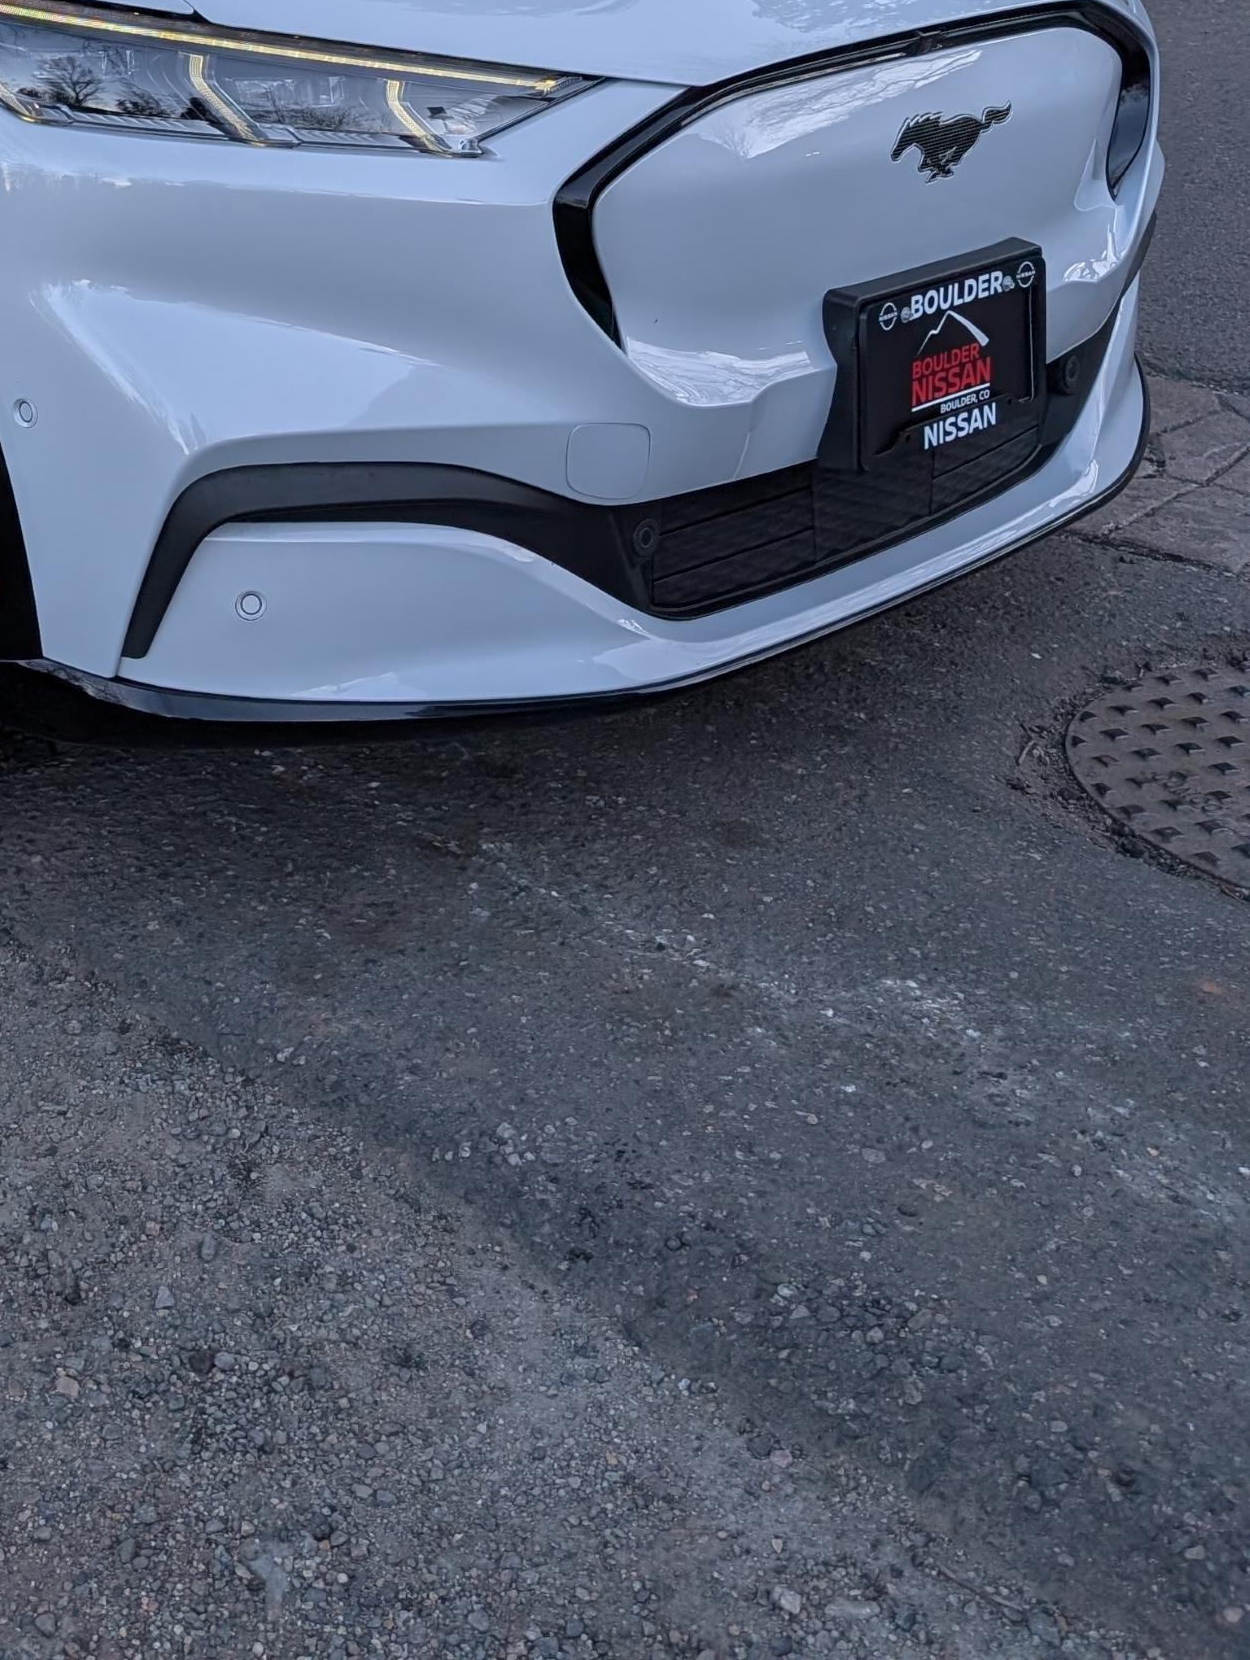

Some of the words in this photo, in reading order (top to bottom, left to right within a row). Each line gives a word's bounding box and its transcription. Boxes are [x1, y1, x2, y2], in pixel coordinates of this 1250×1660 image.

[909, 271, 1003, 321] BOULDER
[911, 356, 991, 407] NISSAN
[912, 342, 980, 380] BOULDER
[940, 394, 979, 414] BOULDER,
[979, 389, 991, 402] CO
[923, 402, 997, 450] NISSAN
